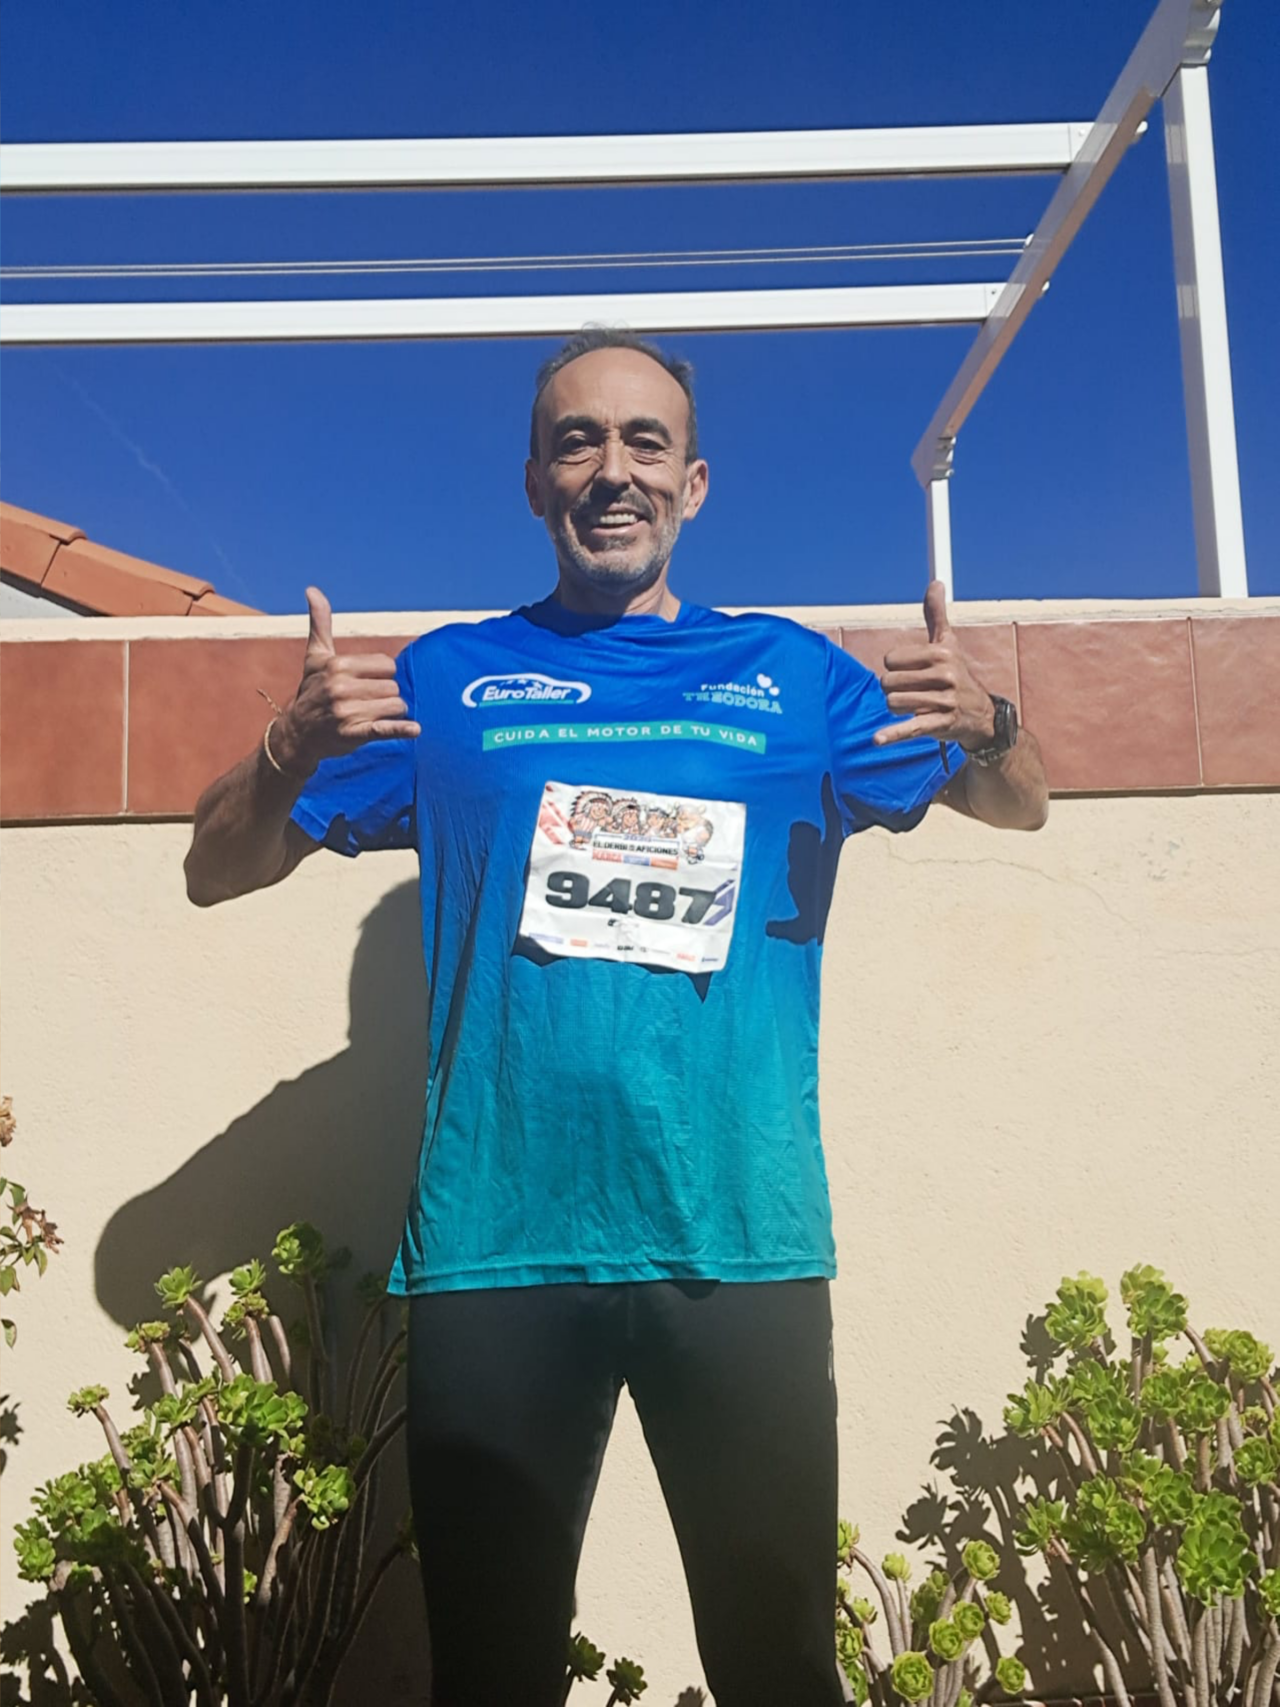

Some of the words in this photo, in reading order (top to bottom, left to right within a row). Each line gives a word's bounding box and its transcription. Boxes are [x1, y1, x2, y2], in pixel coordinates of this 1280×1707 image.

[482, 683, 571, 701] EuroTaller
[701, 682, 765, 698] Fundación
[682, 691, 783, 714] THEODORA
[494, 728, 549, 744] CUIDA
[558, 727, 578, 738] EL
[587, 726, 651, 738] MOTOR
[661, 725, 682, 736] DE
[690, 725, 711, 737] TU
[719, 729, 758, 747] VIDA
[545, 871, 717, 925] 9487
